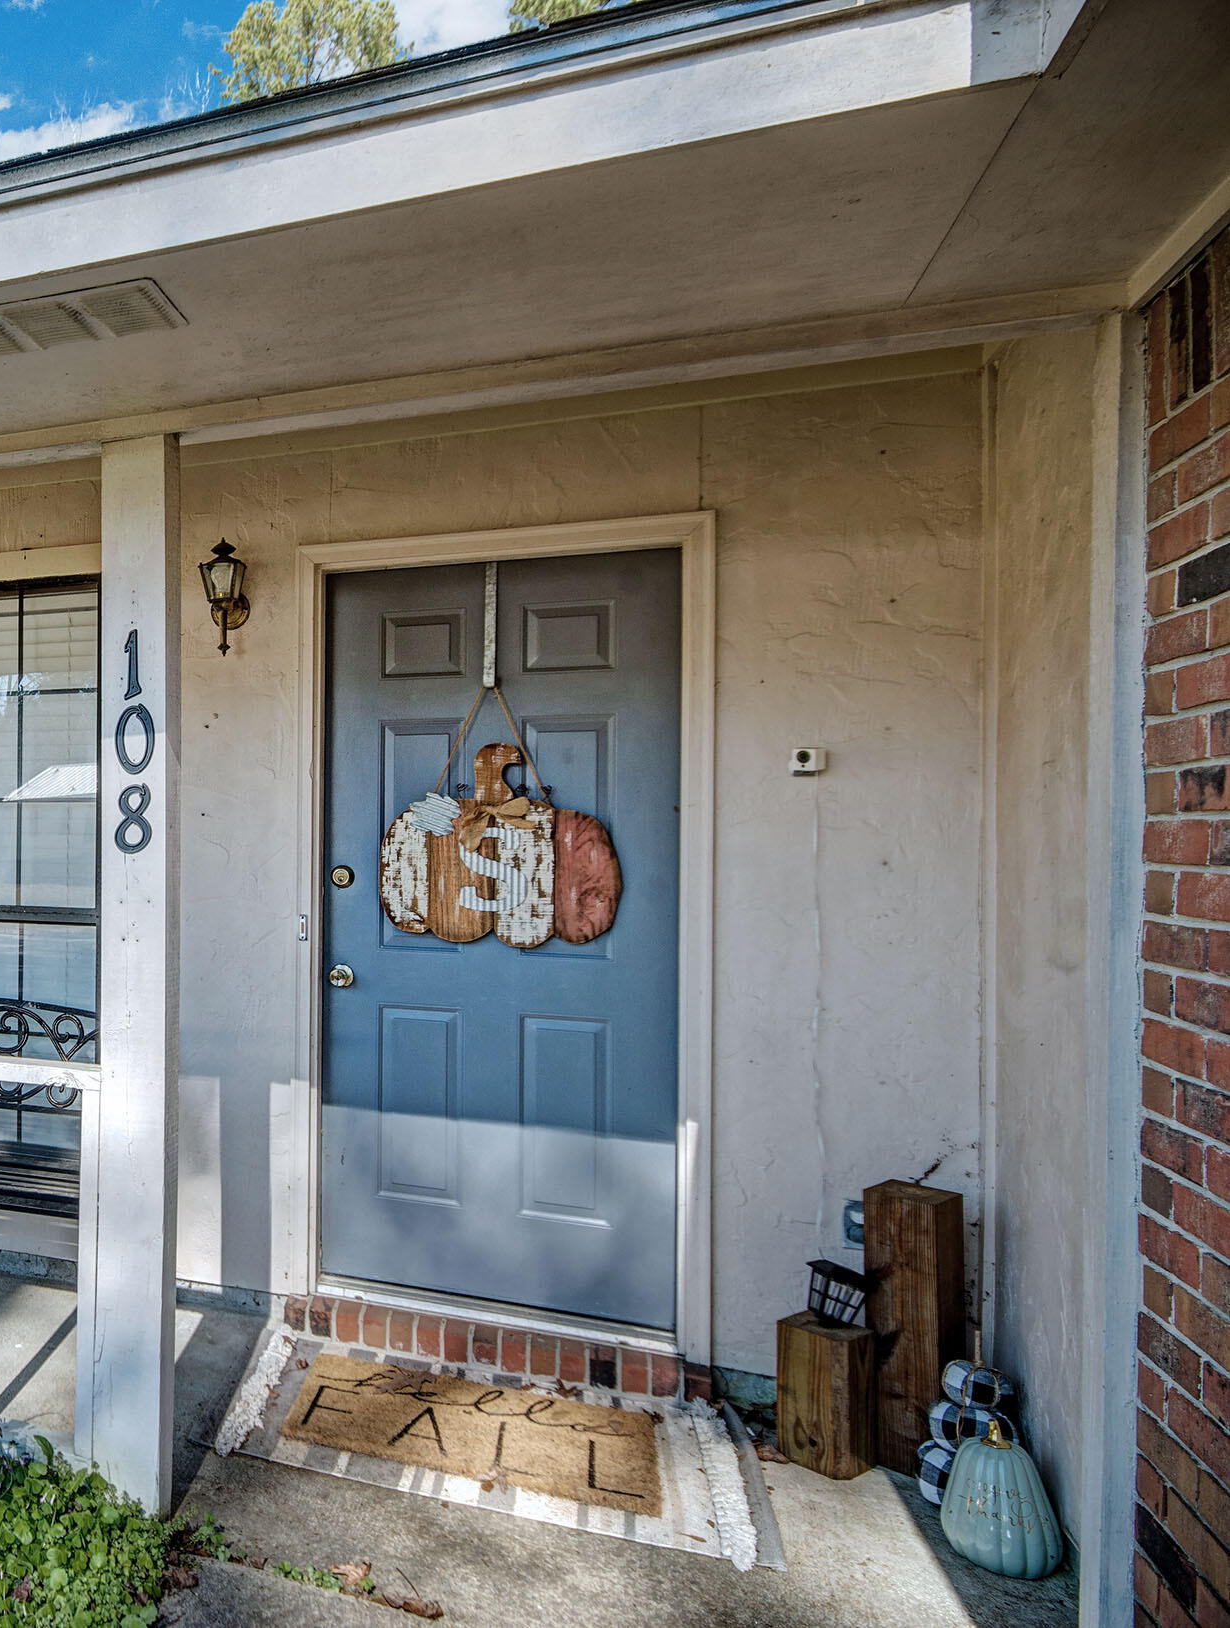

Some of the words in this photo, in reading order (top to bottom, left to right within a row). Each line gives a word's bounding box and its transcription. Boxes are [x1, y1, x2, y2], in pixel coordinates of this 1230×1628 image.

[115, 629, 156, 855] 108
[459, 826, 528, 912] S
[301, 1385, 647, 1500] FALL
